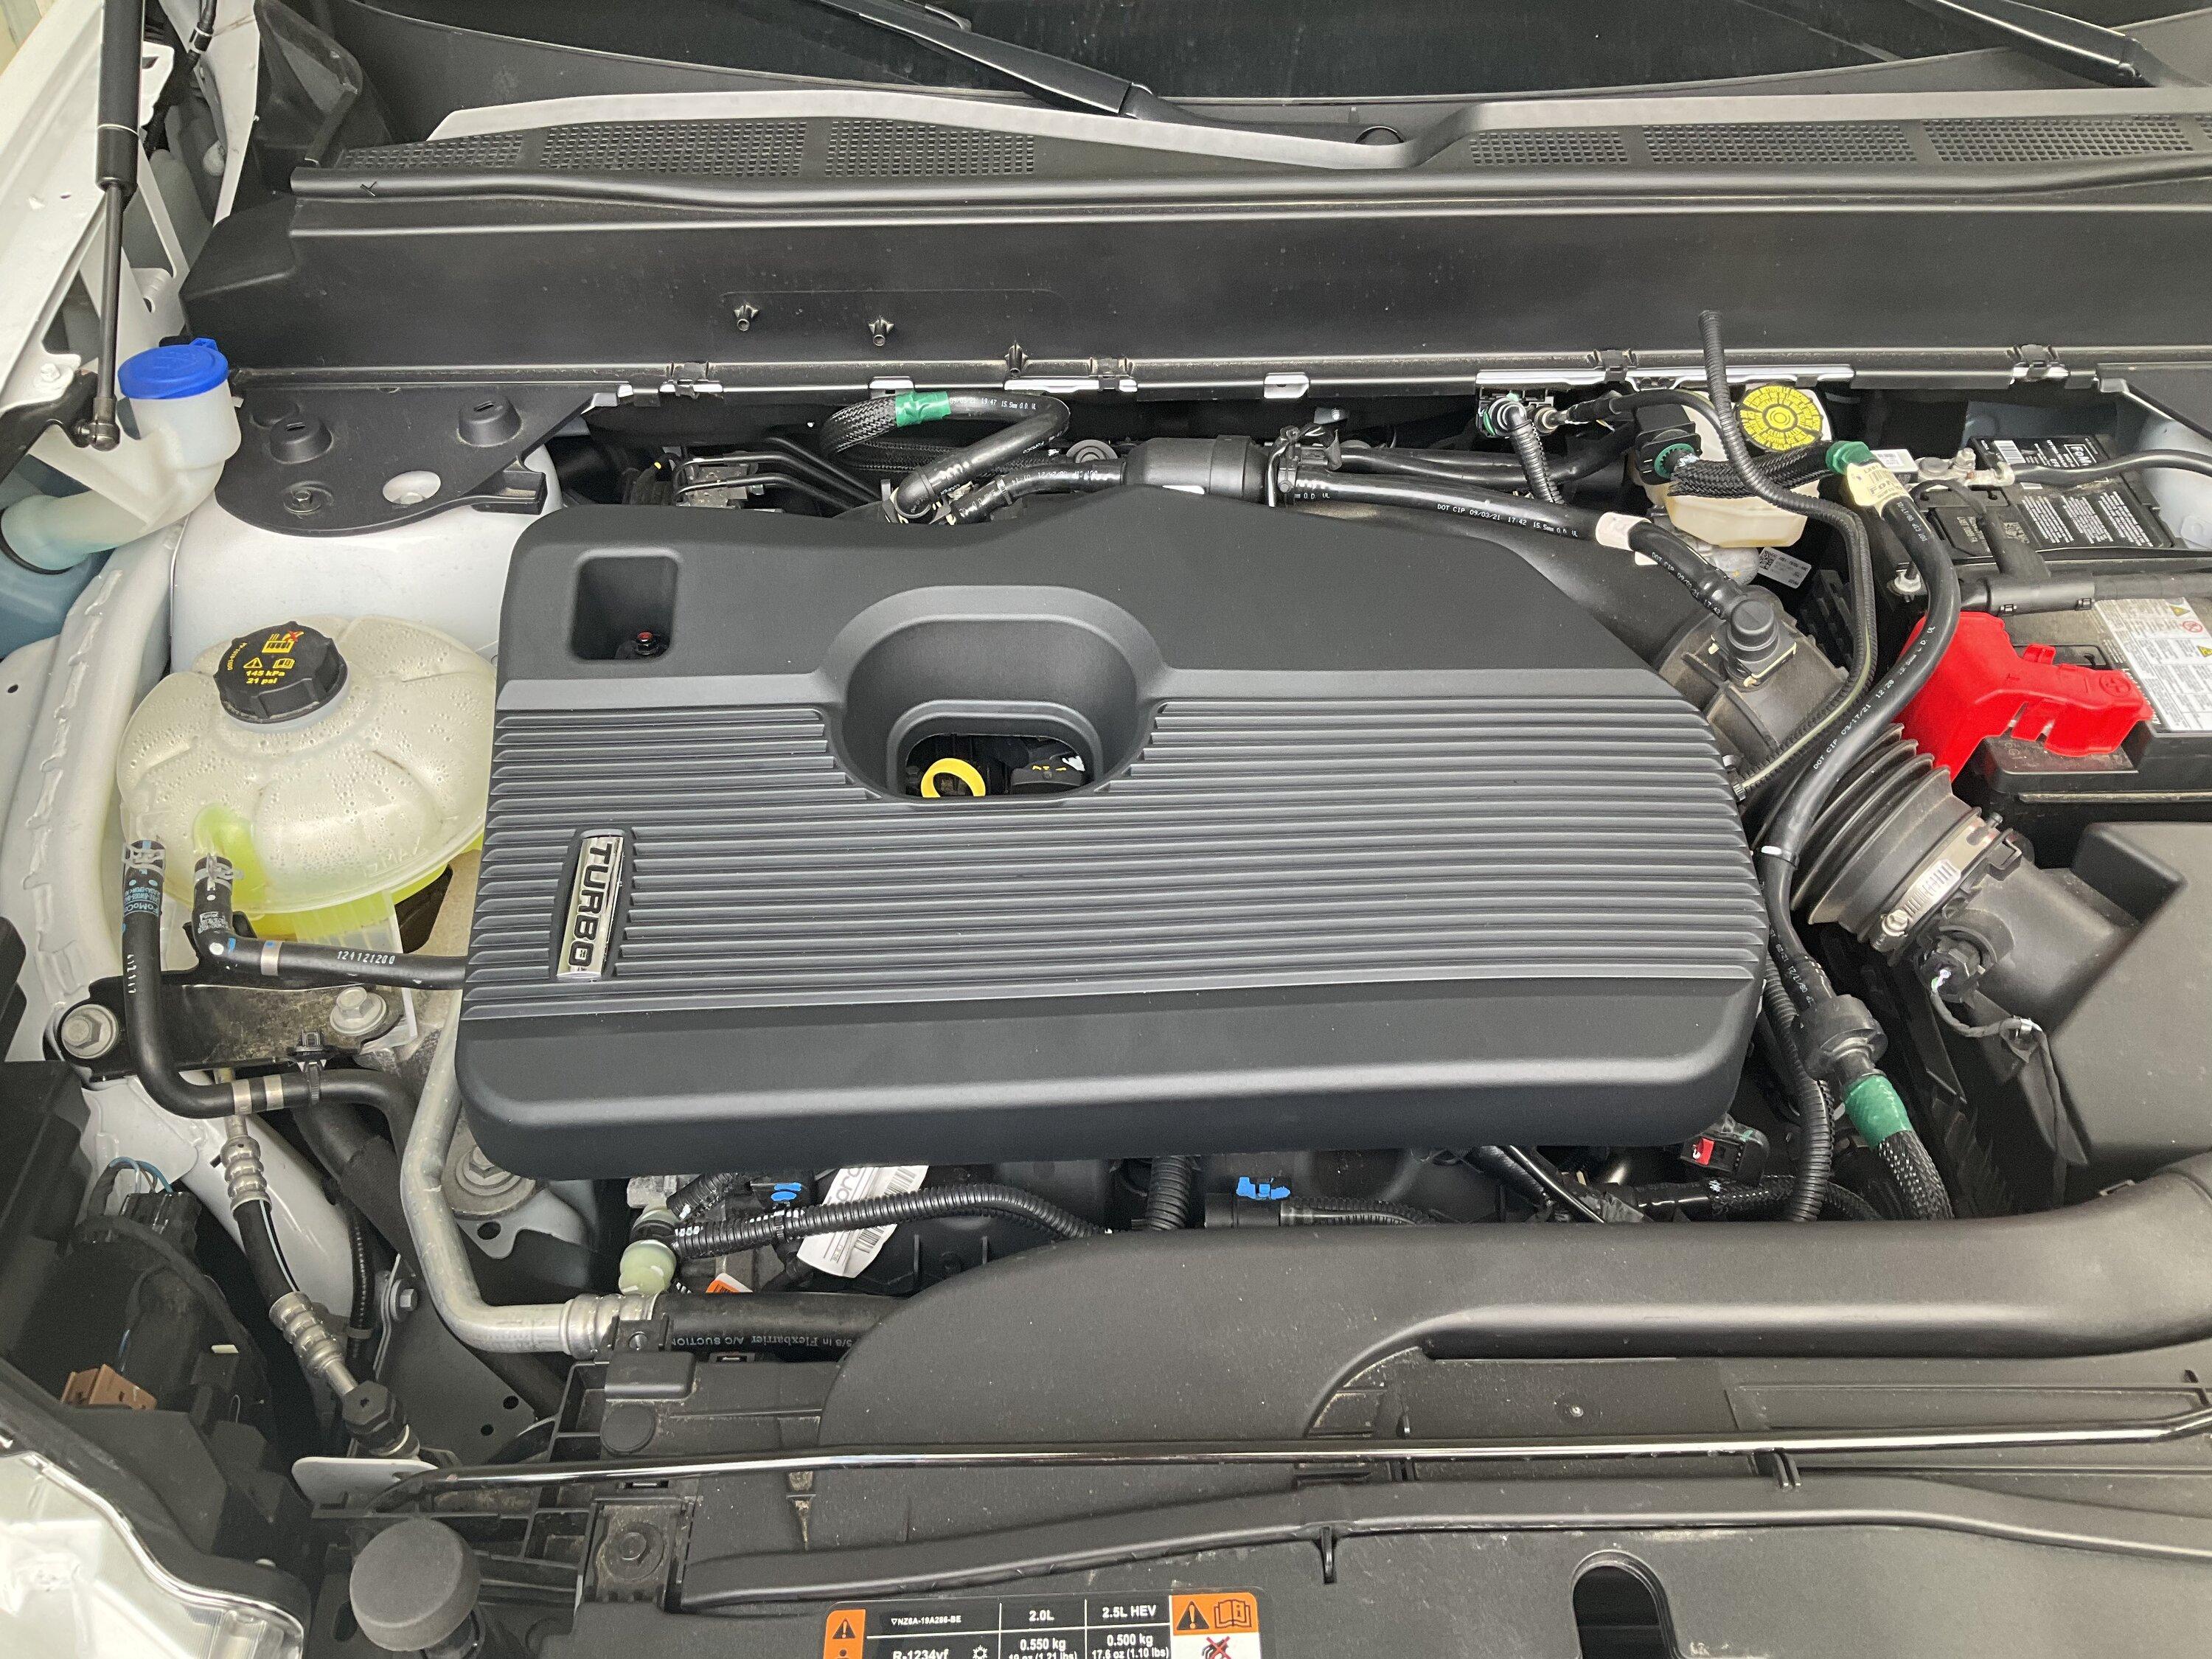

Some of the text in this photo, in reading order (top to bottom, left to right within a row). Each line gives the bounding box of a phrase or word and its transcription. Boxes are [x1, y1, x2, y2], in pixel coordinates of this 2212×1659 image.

[1470, 509, 1501, 521] 09/03/21
[1507, 517, 1528, 526] 17:42
[1911, 522, 1921, 532] CIP
[1918, 533, 1928, 542] DOT
[1652, 552, 1663, 562] DOT
[1813, 754, 1825, 770] DOT
[1826, 739, 1837, 753] CIP
[1875, 679, 1894, 699] 12:28
[568, 842, 613, 967] TURBO
[671, 1335, 721, 1346] SUCTION
[724, 1336, 744, 1345] A/C
[751, 1335, 818, 1347] Flexbarrier
[836, 1338, 853, 1347] 5/8
[1029, 1610, 1054, 1621] 2.0L
[1102, 1606, 1127, 1618] 2.5L
[1130, 1604, 1157, 1617] HEV
[1020, 1638, 1066, 1652] 0.550 kg
[1107, 1633, 1153, 1647] 0.500 kg
[1092, 1646, 1170, 1659] 17.6 oz (1.10 lbs)
